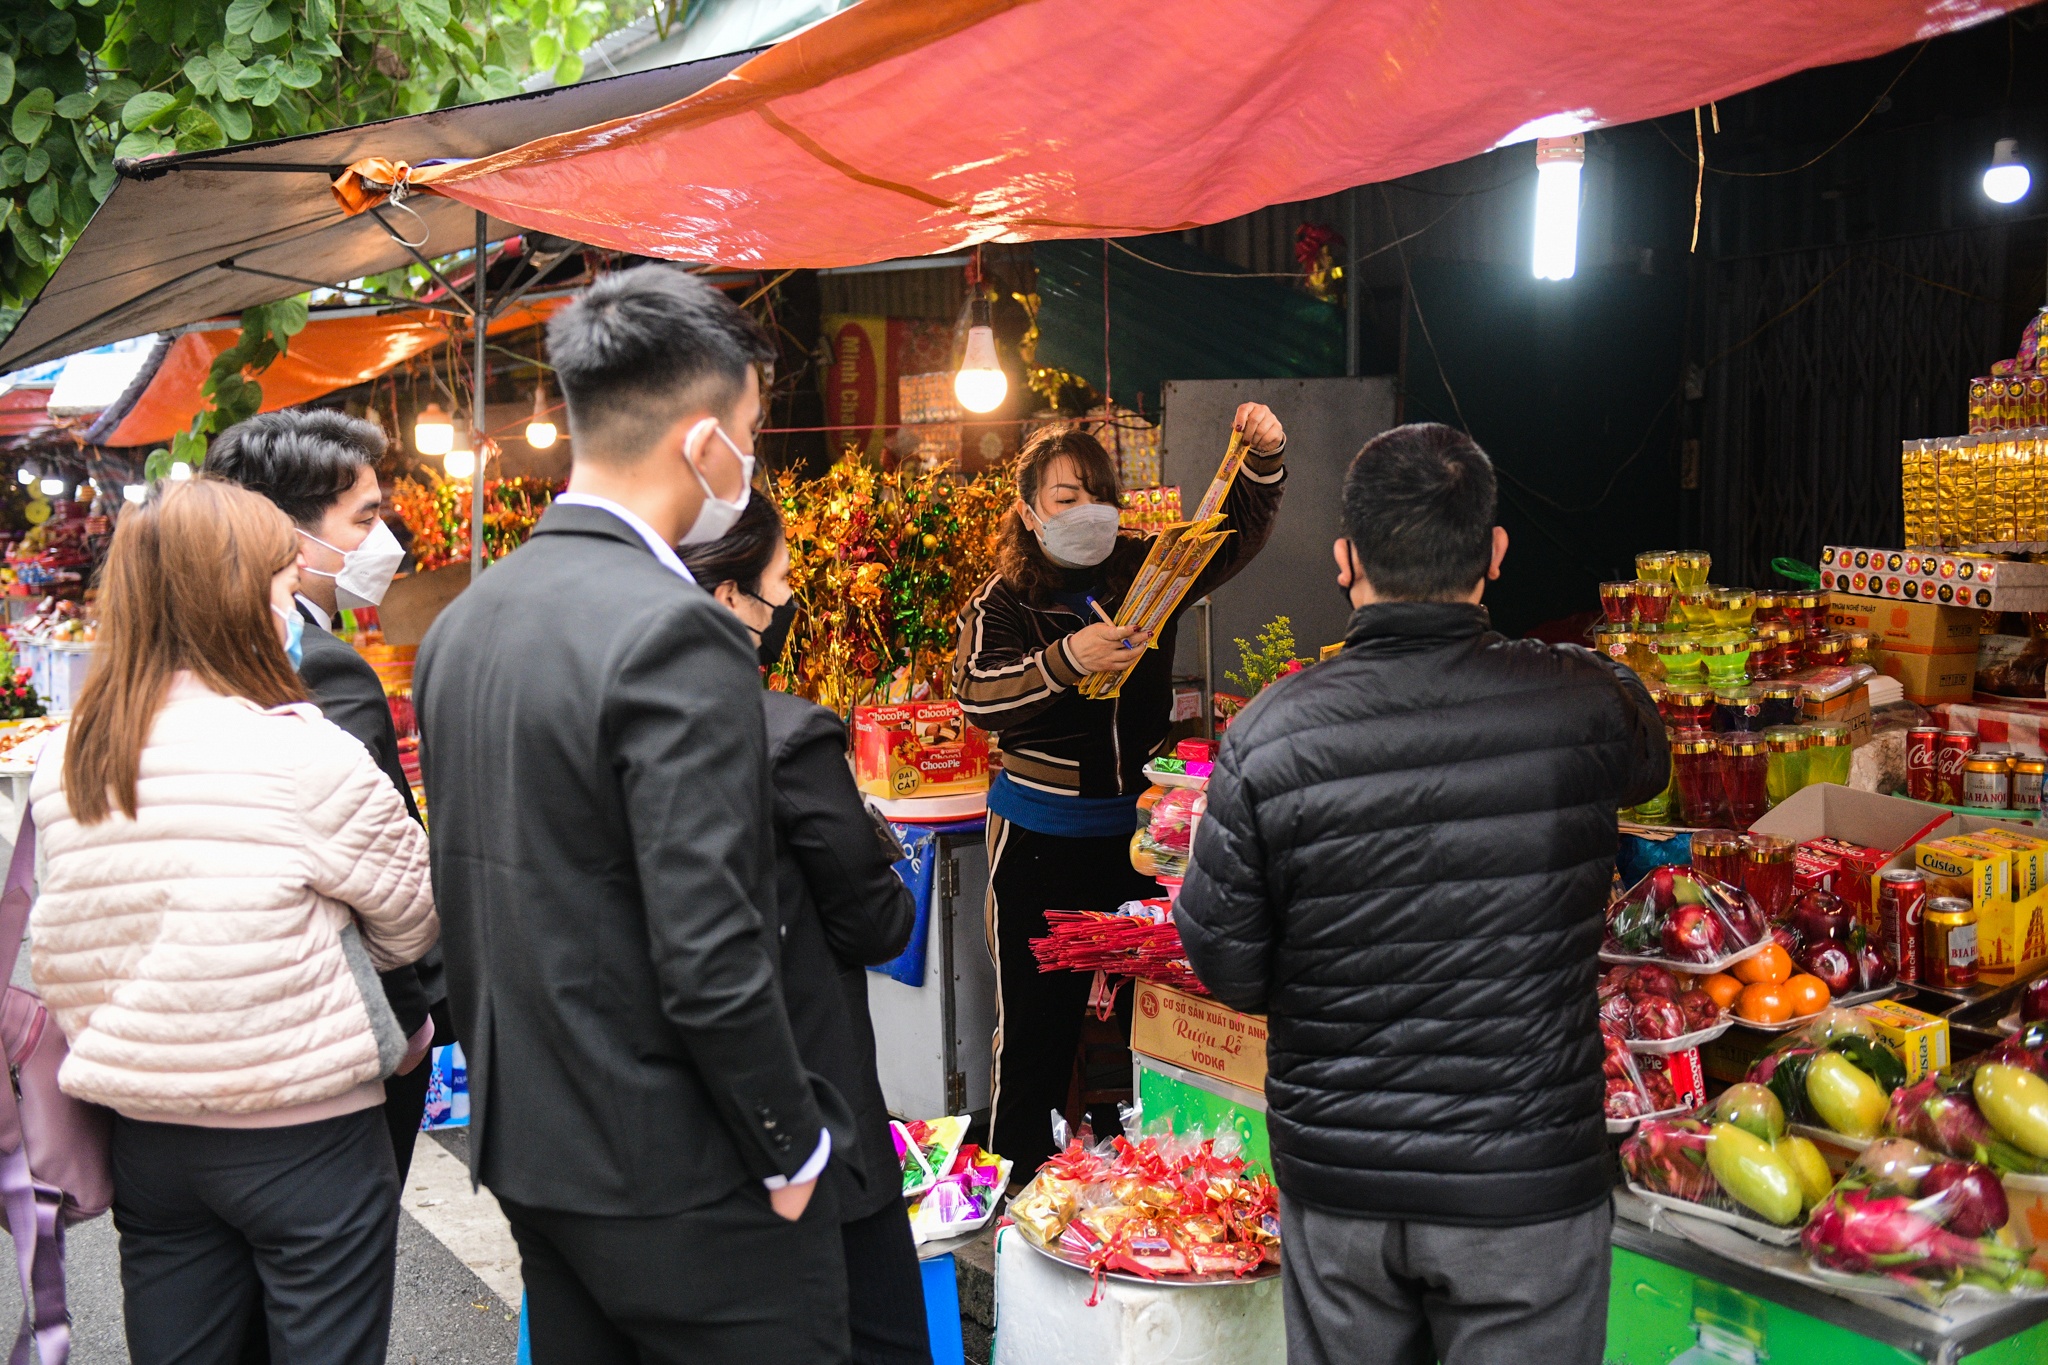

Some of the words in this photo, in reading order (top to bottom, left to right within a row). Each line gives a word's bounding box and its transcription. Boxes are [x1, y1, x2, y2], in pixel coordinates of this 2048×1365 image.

[1922, 853, 1963, 875] Custas
[1163, 996, 1174, 1010] CƠ
[1187, 1003, 1204, 1020] SẢN
[1206, 1012, 1227, 1028] XUẤT
[1229, 1018, 1245, 1034] DUY
[1247, 1025, 1266, 1041] ANH
[1172, 1017, 1216, 1049] Rượu
[1220, 1034, 1243, 1056] Lễ
[1191, 1049, 1225, 1071] VODKA
